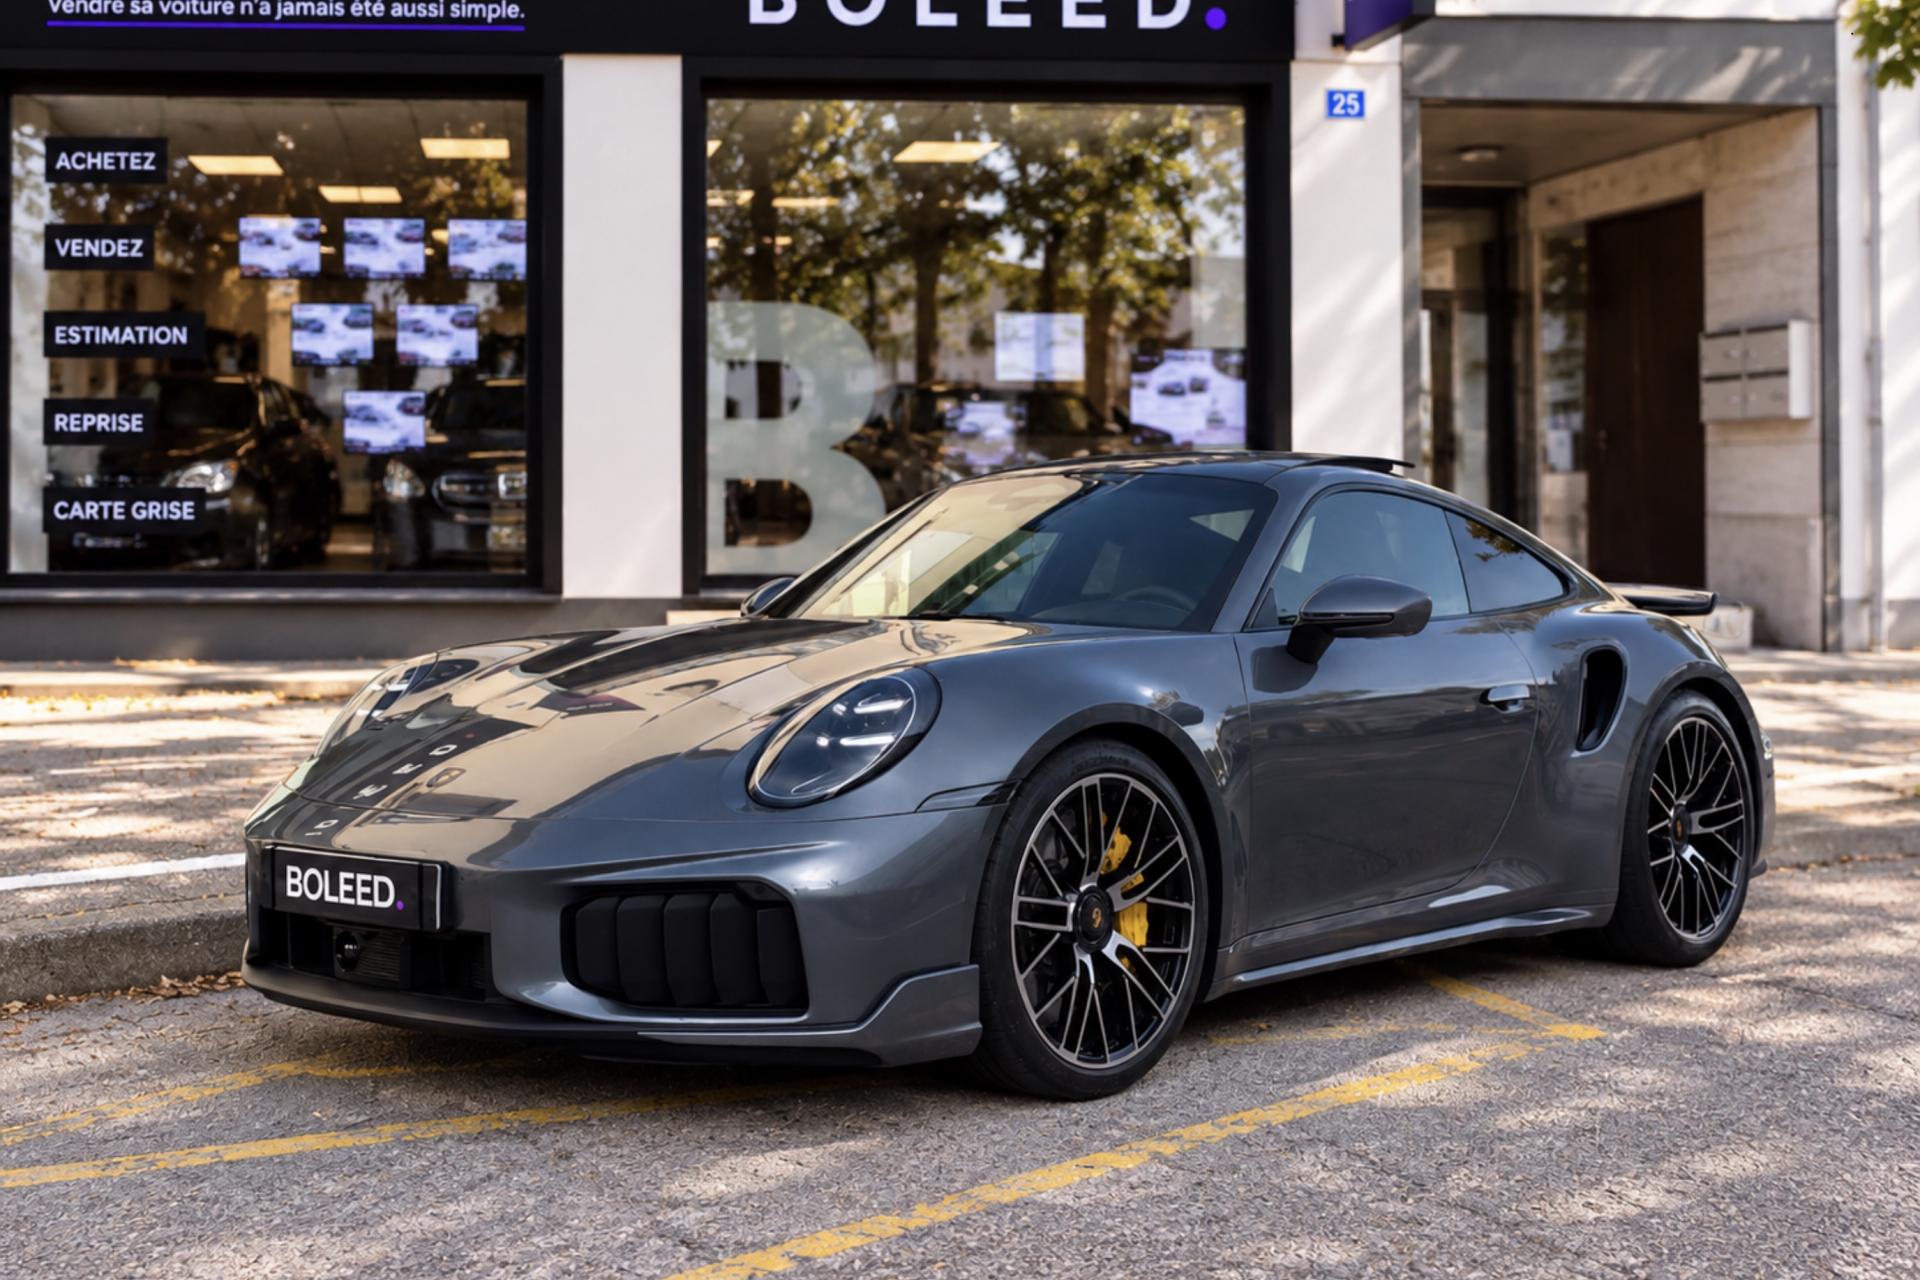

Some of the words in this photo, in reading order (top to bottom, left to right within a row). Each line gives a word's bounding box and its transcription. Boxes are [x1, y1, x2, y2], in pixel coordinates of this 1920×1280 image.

[48, 0, 125, 14] Vendre
[130, 0, 154, 15] sa
[158, 0, 235, 15] voiture
[274, 0, 345, 21] jamais
[350, 0, 386, 17] été
[390, 0, 445, 18] aussi
[450, 0, 525, 23] simple.
[1332, 92, 1360, 116] 25
[55, 151, 156, 171] ACHETEZ
[55, 238, 144, 258] VENDEZ
[55, 325, 188, 345] ESTIMATION
[54, 413, 144, 433] REPRISE
[707, 301, 886, 574] B
[53, 500, 126, 520] CARTE
[131, 500, 195, 520] GRISE
[285, 865, 404, 911] BOLEED.
